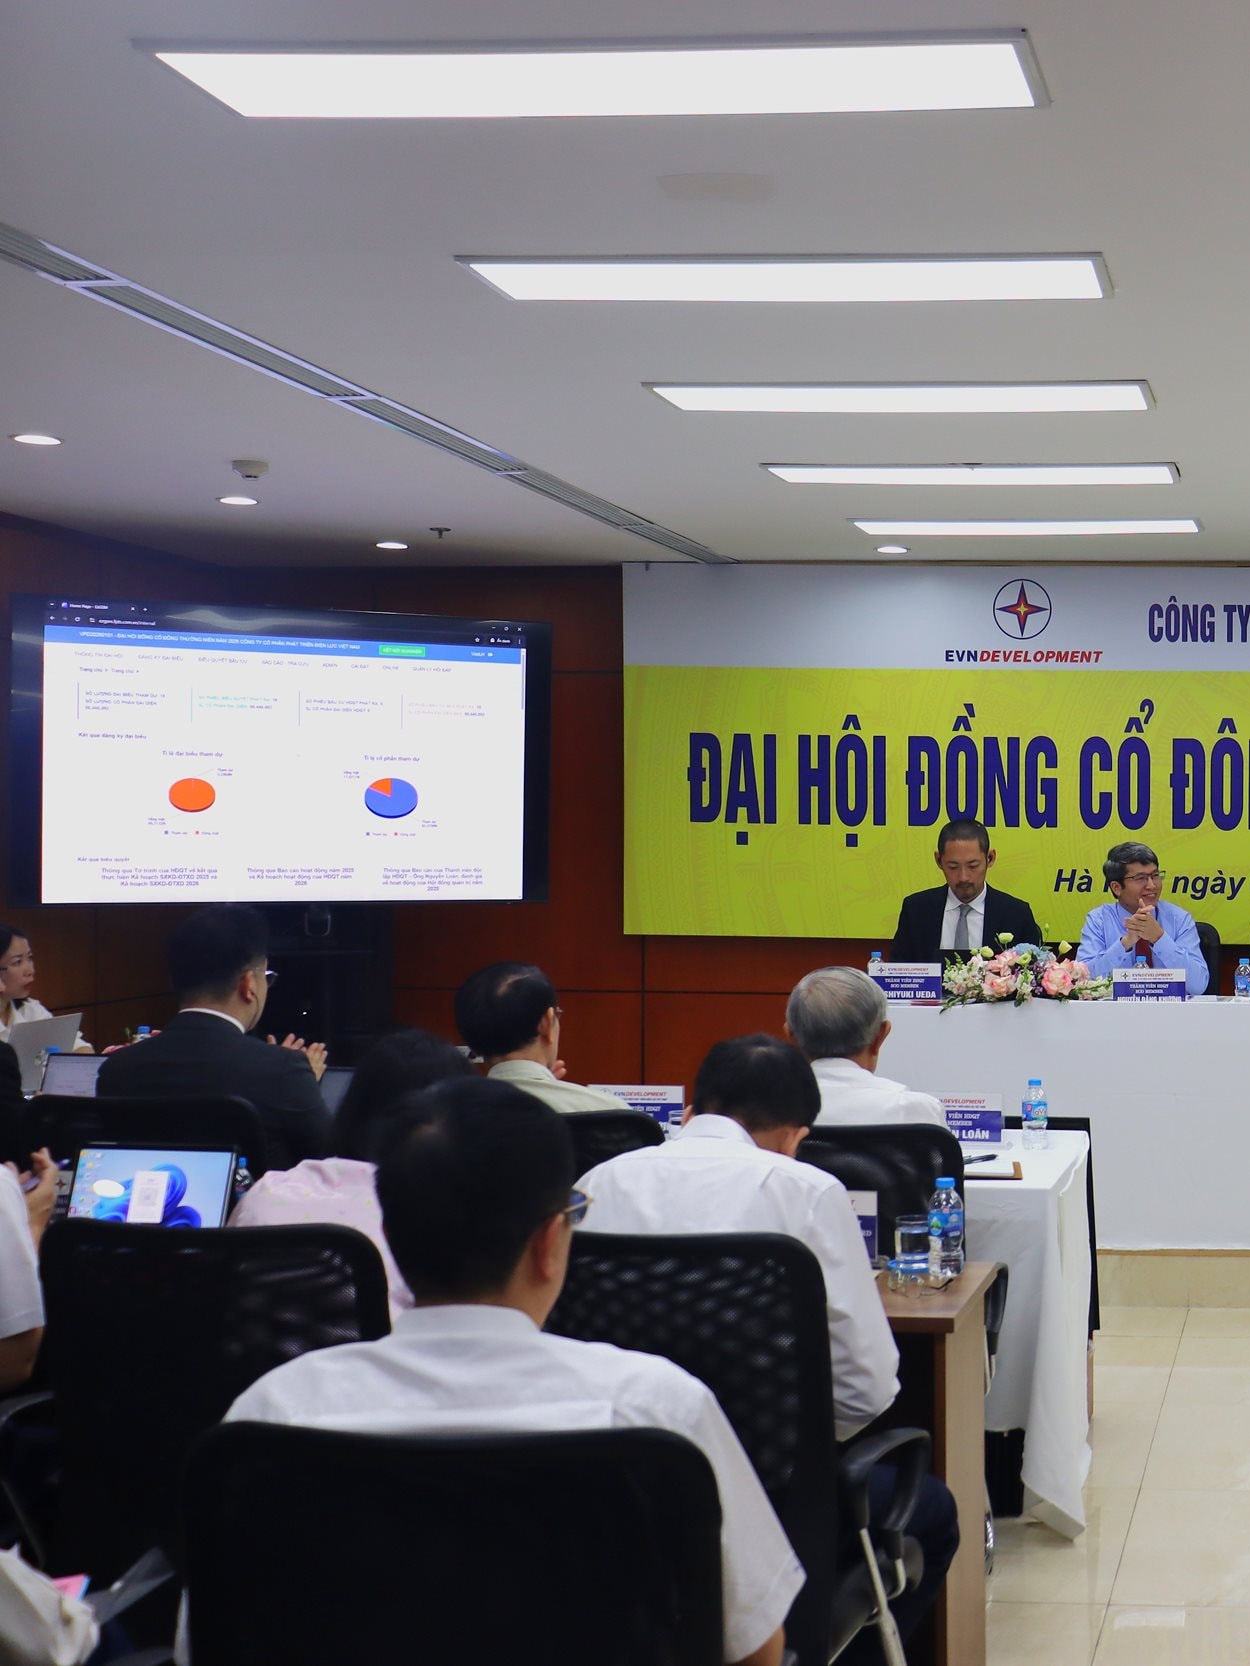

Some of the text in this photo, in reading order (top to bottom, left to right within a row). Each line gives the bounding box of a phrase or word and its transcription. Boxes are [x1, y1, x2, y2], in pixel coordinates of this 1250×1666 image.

[1148, 594, 1214, 643] CÔNG
[1225, 605, 1249, 641] TY
[945, 650, 1103, 663] EVNDEVELOPMENT
[687, 732, 776, 846] ĐẠI
[799, 714, 886, 847] HỘI
[906, 703, 1058, 829] ĐỒNG
[1079, 698, 1154, 830] CỔ
[1053, 868, 1093, 893] Hà
[1171, 869, 1247, 901] ngày
[884, 990, 937, 998] SHIYUKI UEDA
